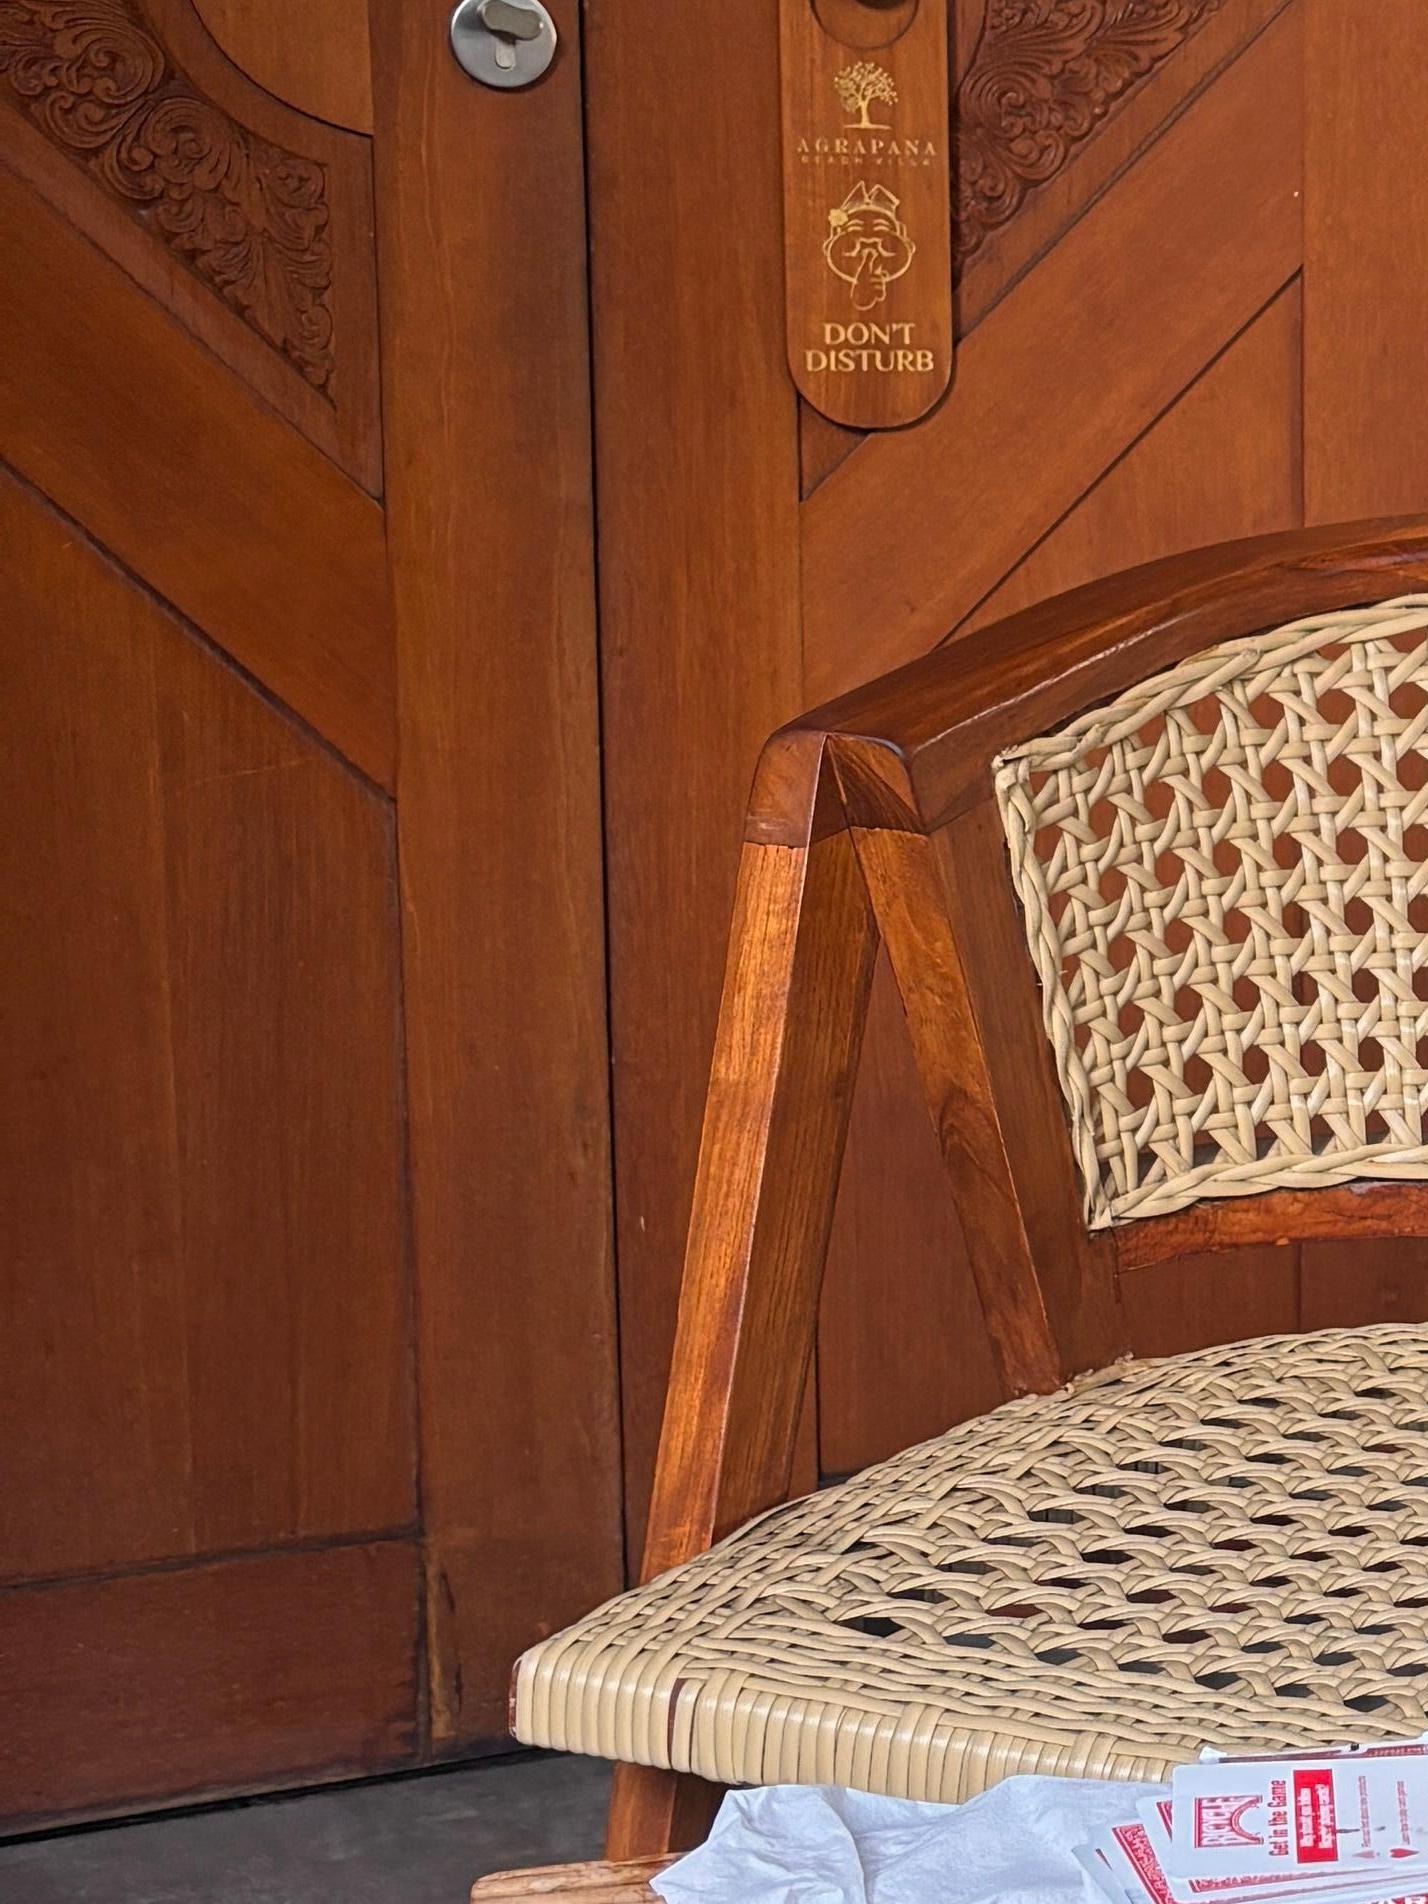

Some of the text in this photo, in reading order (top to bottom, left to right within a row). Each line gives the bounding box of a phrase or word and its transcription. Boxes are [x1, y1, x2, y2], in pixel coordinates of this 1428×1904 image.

[797, 138, 936, 155] AGRAPANA
[824, 322, 916, 345] DON'T
[805, 349, 934, 372] DISTURB
[1201, 1796, 1262, 1848] BICYCLE
[1267, 1780, 1289, 1856] Get in the Game
